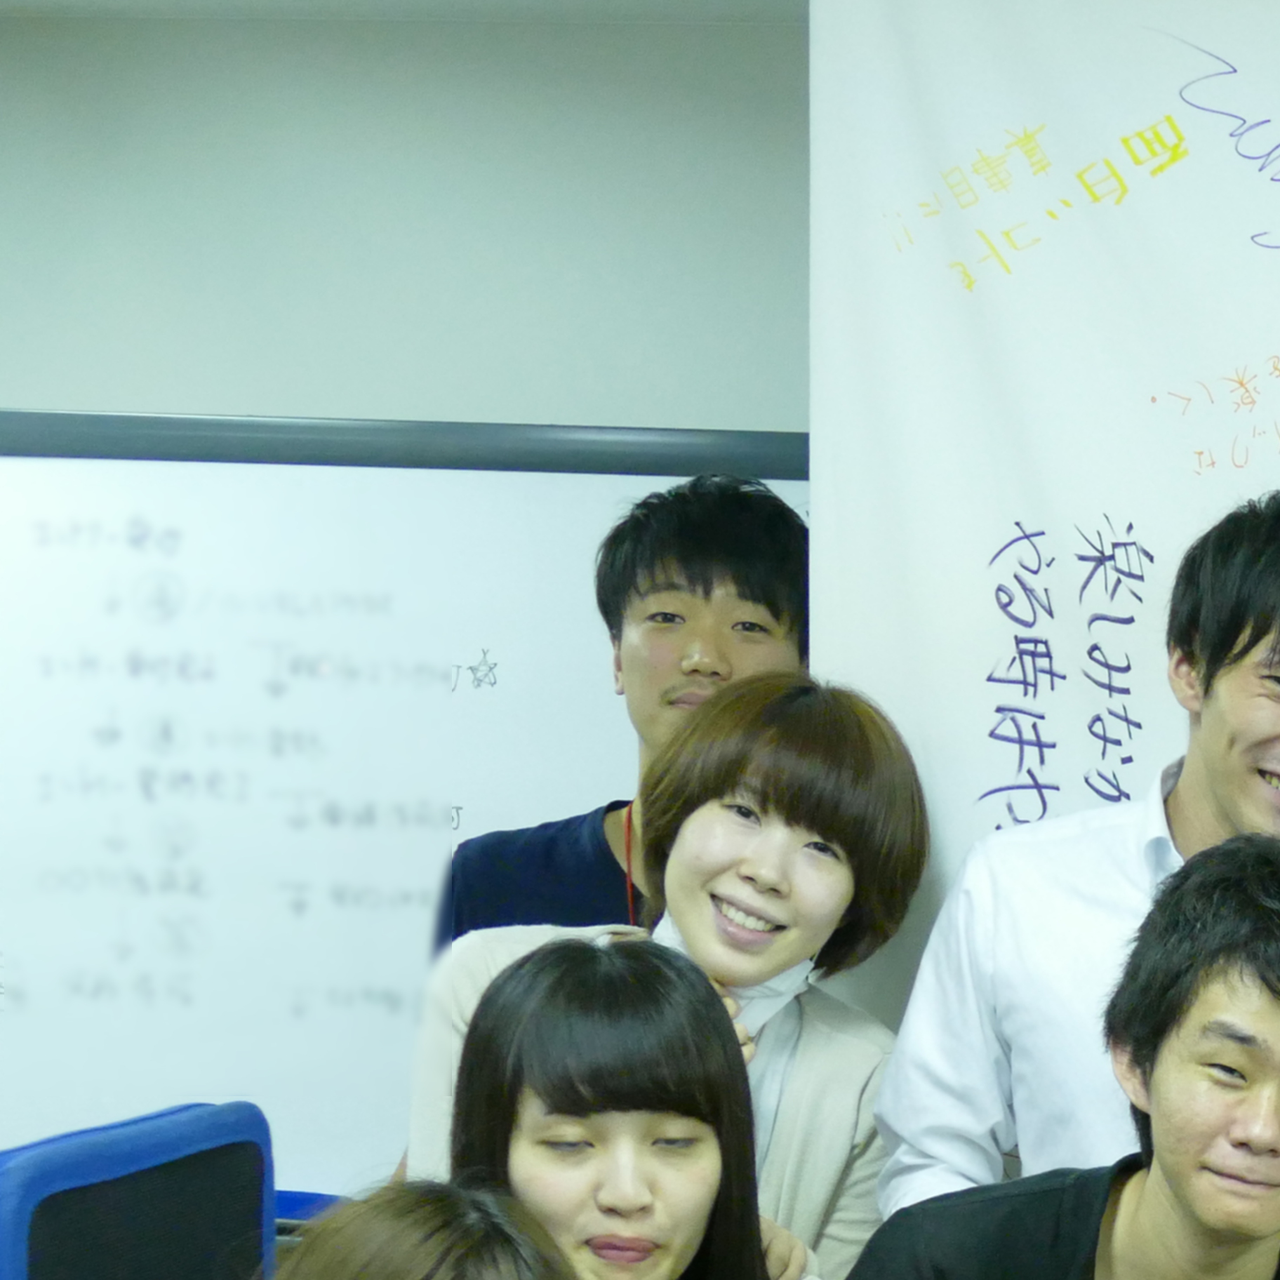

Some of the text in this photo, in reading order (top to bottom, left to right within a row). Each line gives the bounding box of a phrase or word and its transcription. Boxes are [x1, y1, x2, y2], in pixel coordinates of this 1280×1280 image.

[974, 521, 1068, 831] やる時はや
